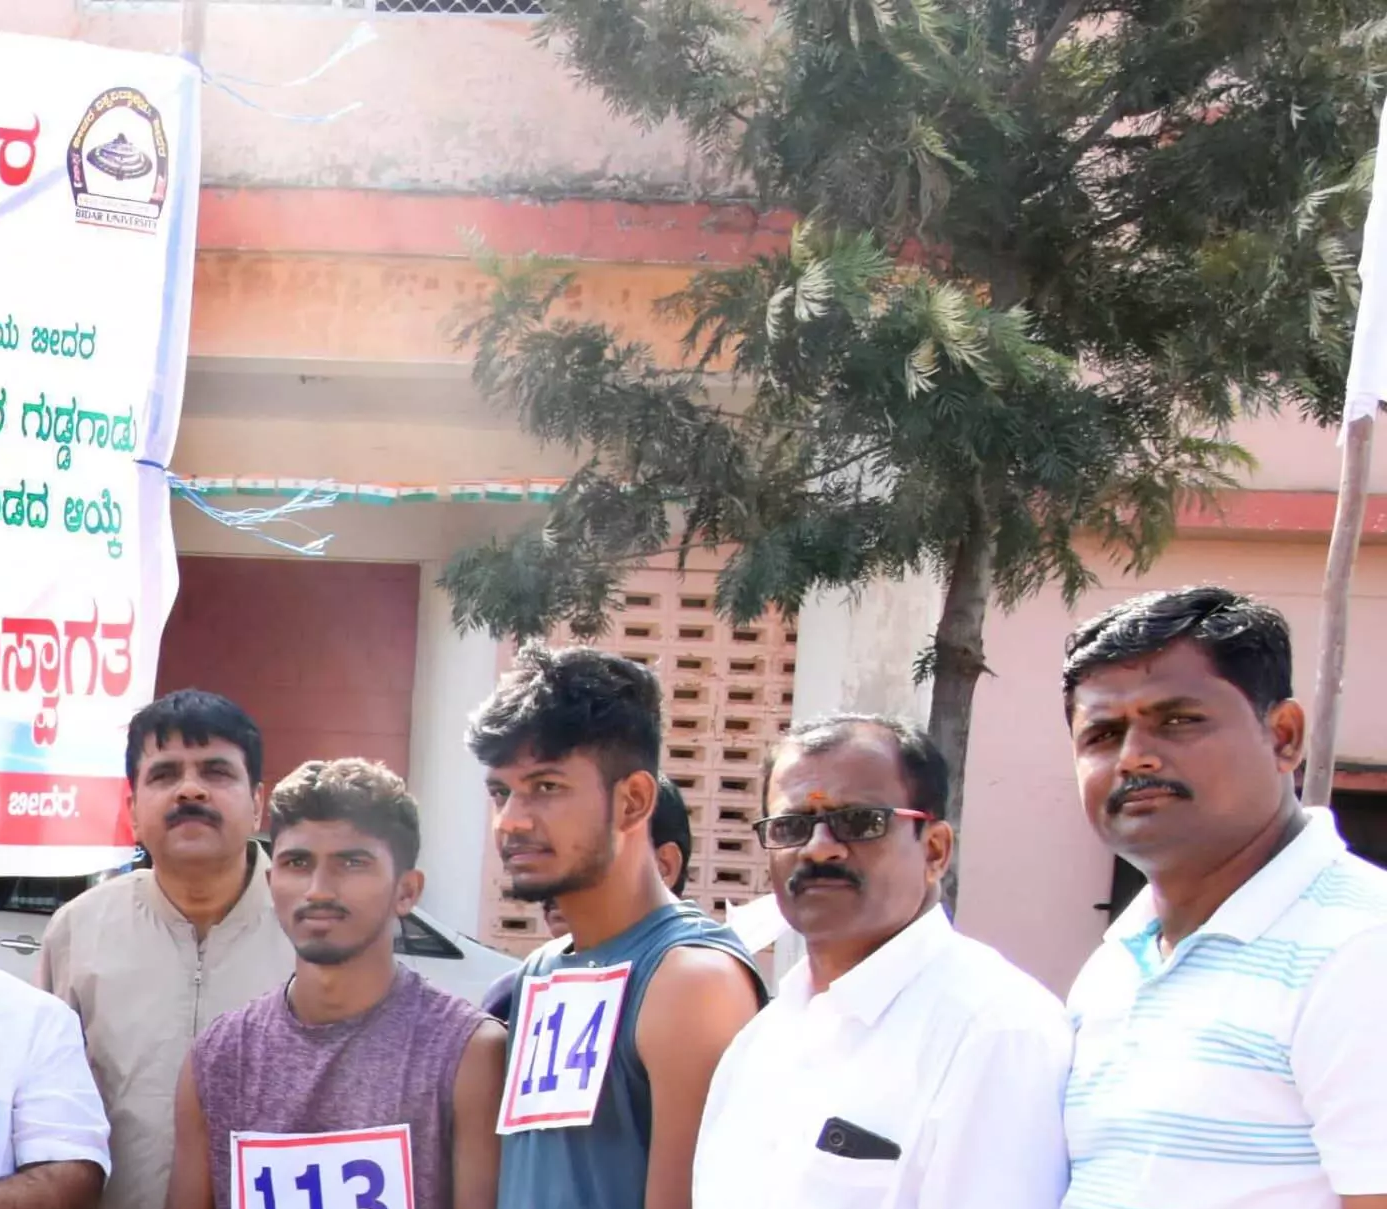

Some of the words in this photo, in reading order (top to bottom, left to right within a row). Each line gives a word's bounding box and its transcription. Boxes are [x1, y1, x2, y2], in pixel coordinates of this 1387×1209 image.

[75, 208, 103, 221] BIDAR
[31, 322, 97, 360] ಬೀದರ
[21, 391, 138, 471] ಗುಡ್ಡಗಾಡು
[63, 488, 123, 559] ಆಯ್ಕೆ
[521, 999, 607, 1096] 114
